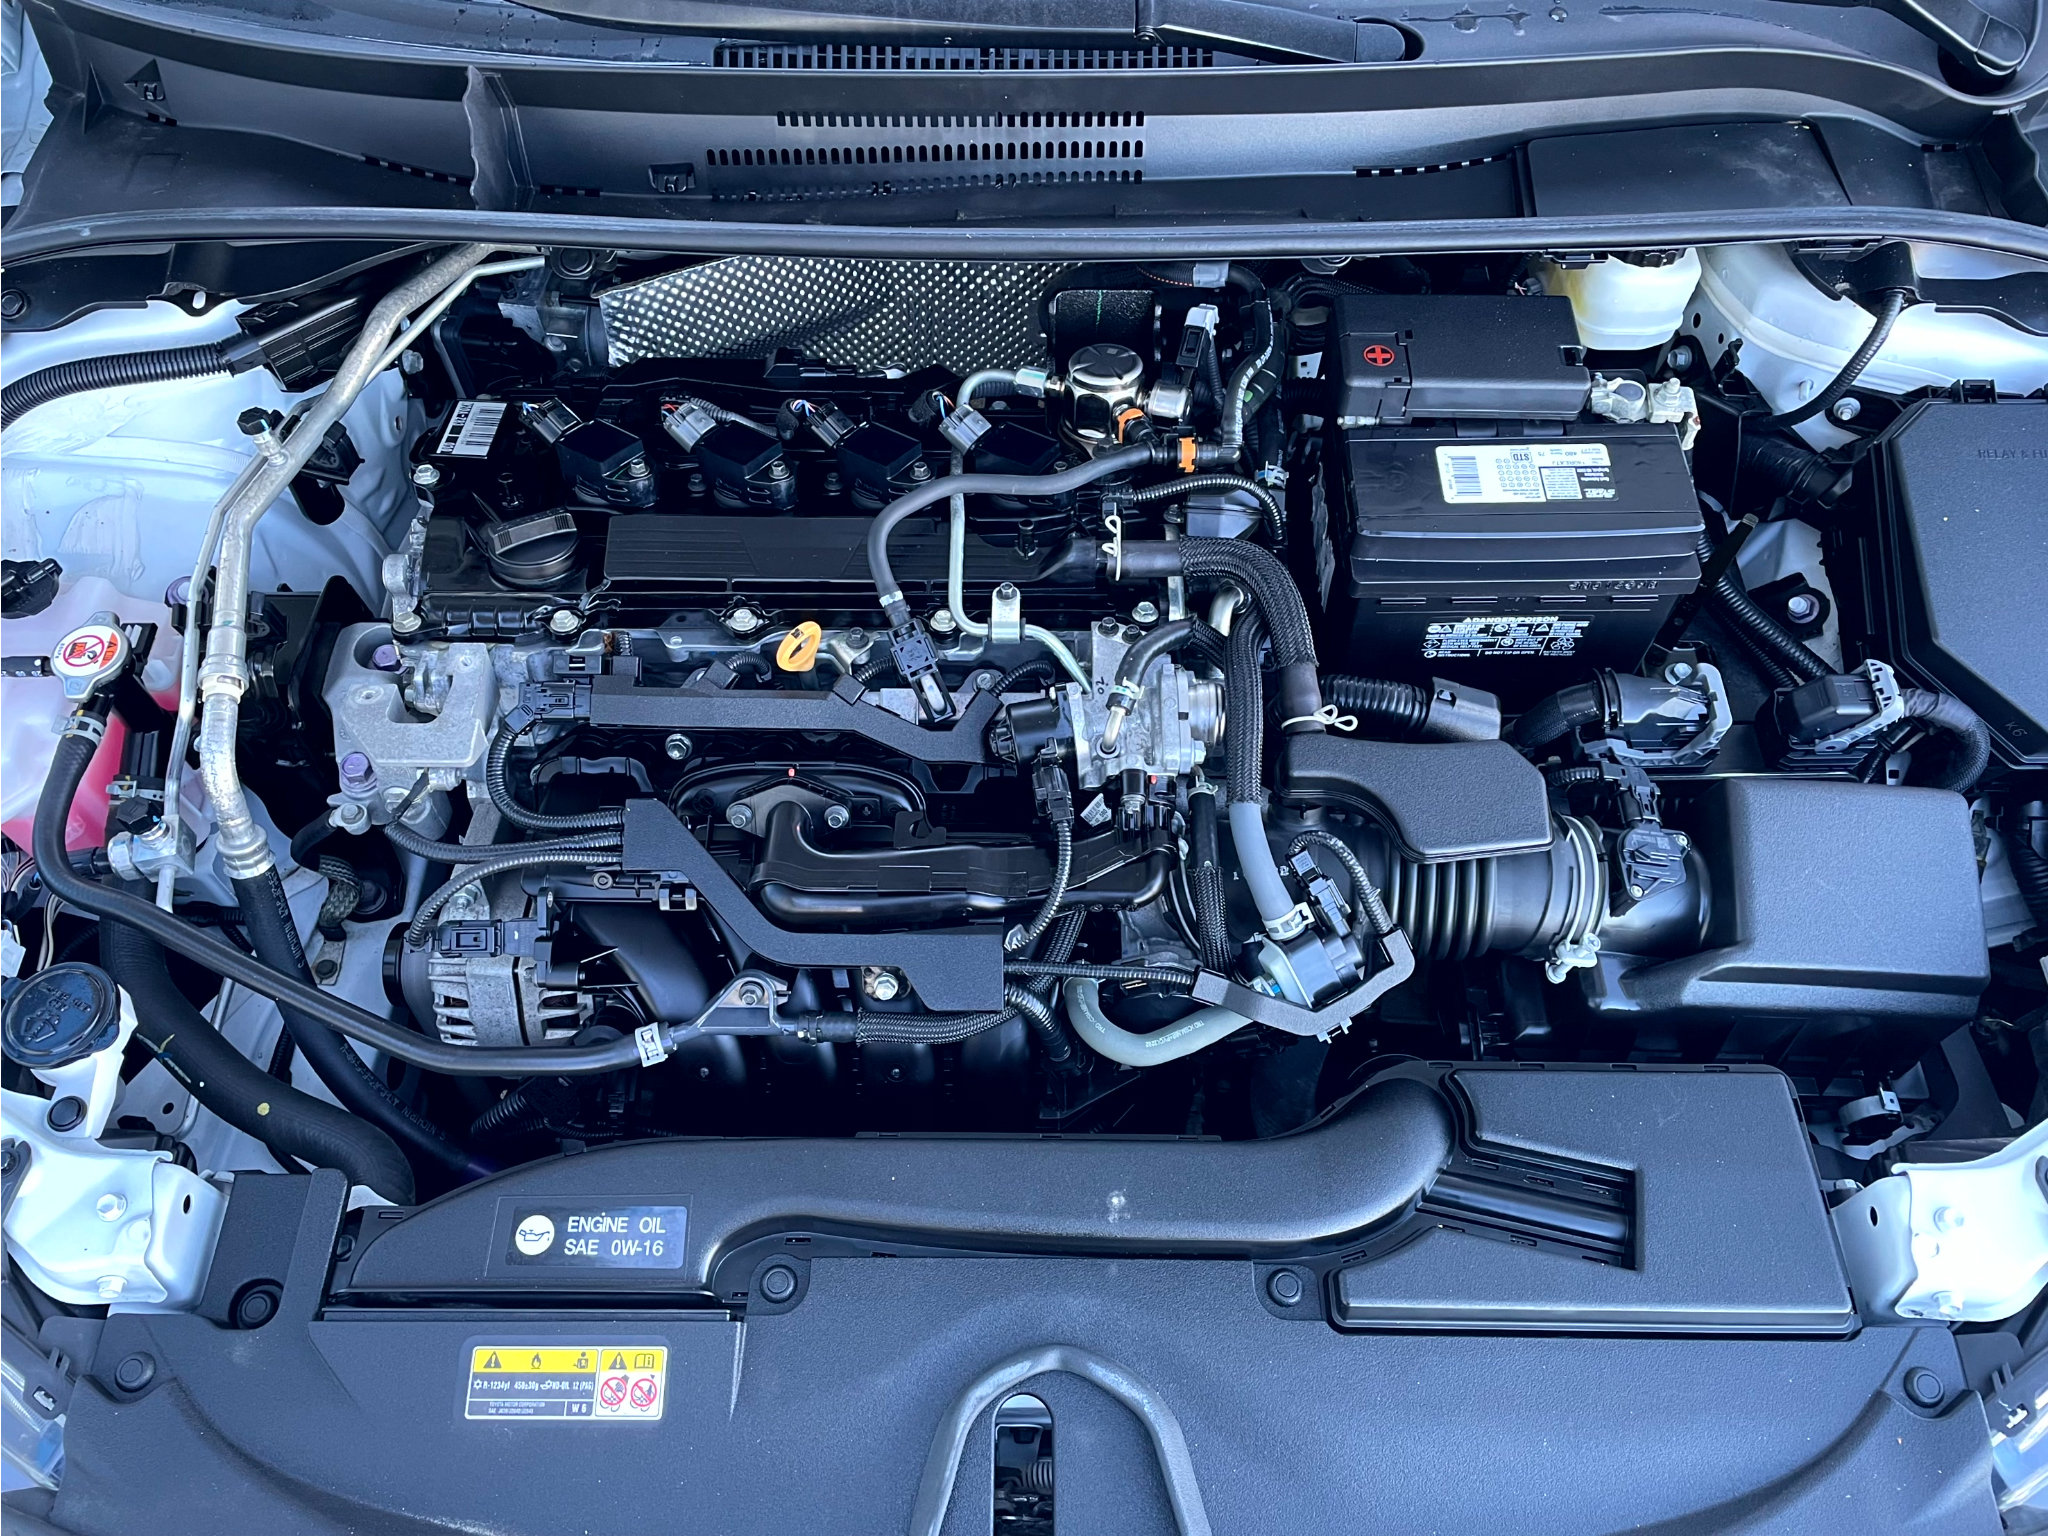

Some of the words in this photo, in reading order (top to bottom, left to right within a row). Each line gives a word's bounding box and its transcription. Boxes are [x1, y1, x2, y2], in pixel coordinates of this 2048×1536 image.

[1513, 452, 1530, 461] STD
[1977, 449, 2016, 460] RELAY
[638, 1216, 666, 1234] OIL
[564, 1239, 600, 1256] SAE
[611, 1239, 664, 1257] 0W-16
[571, 1403, 581, 1413] W
